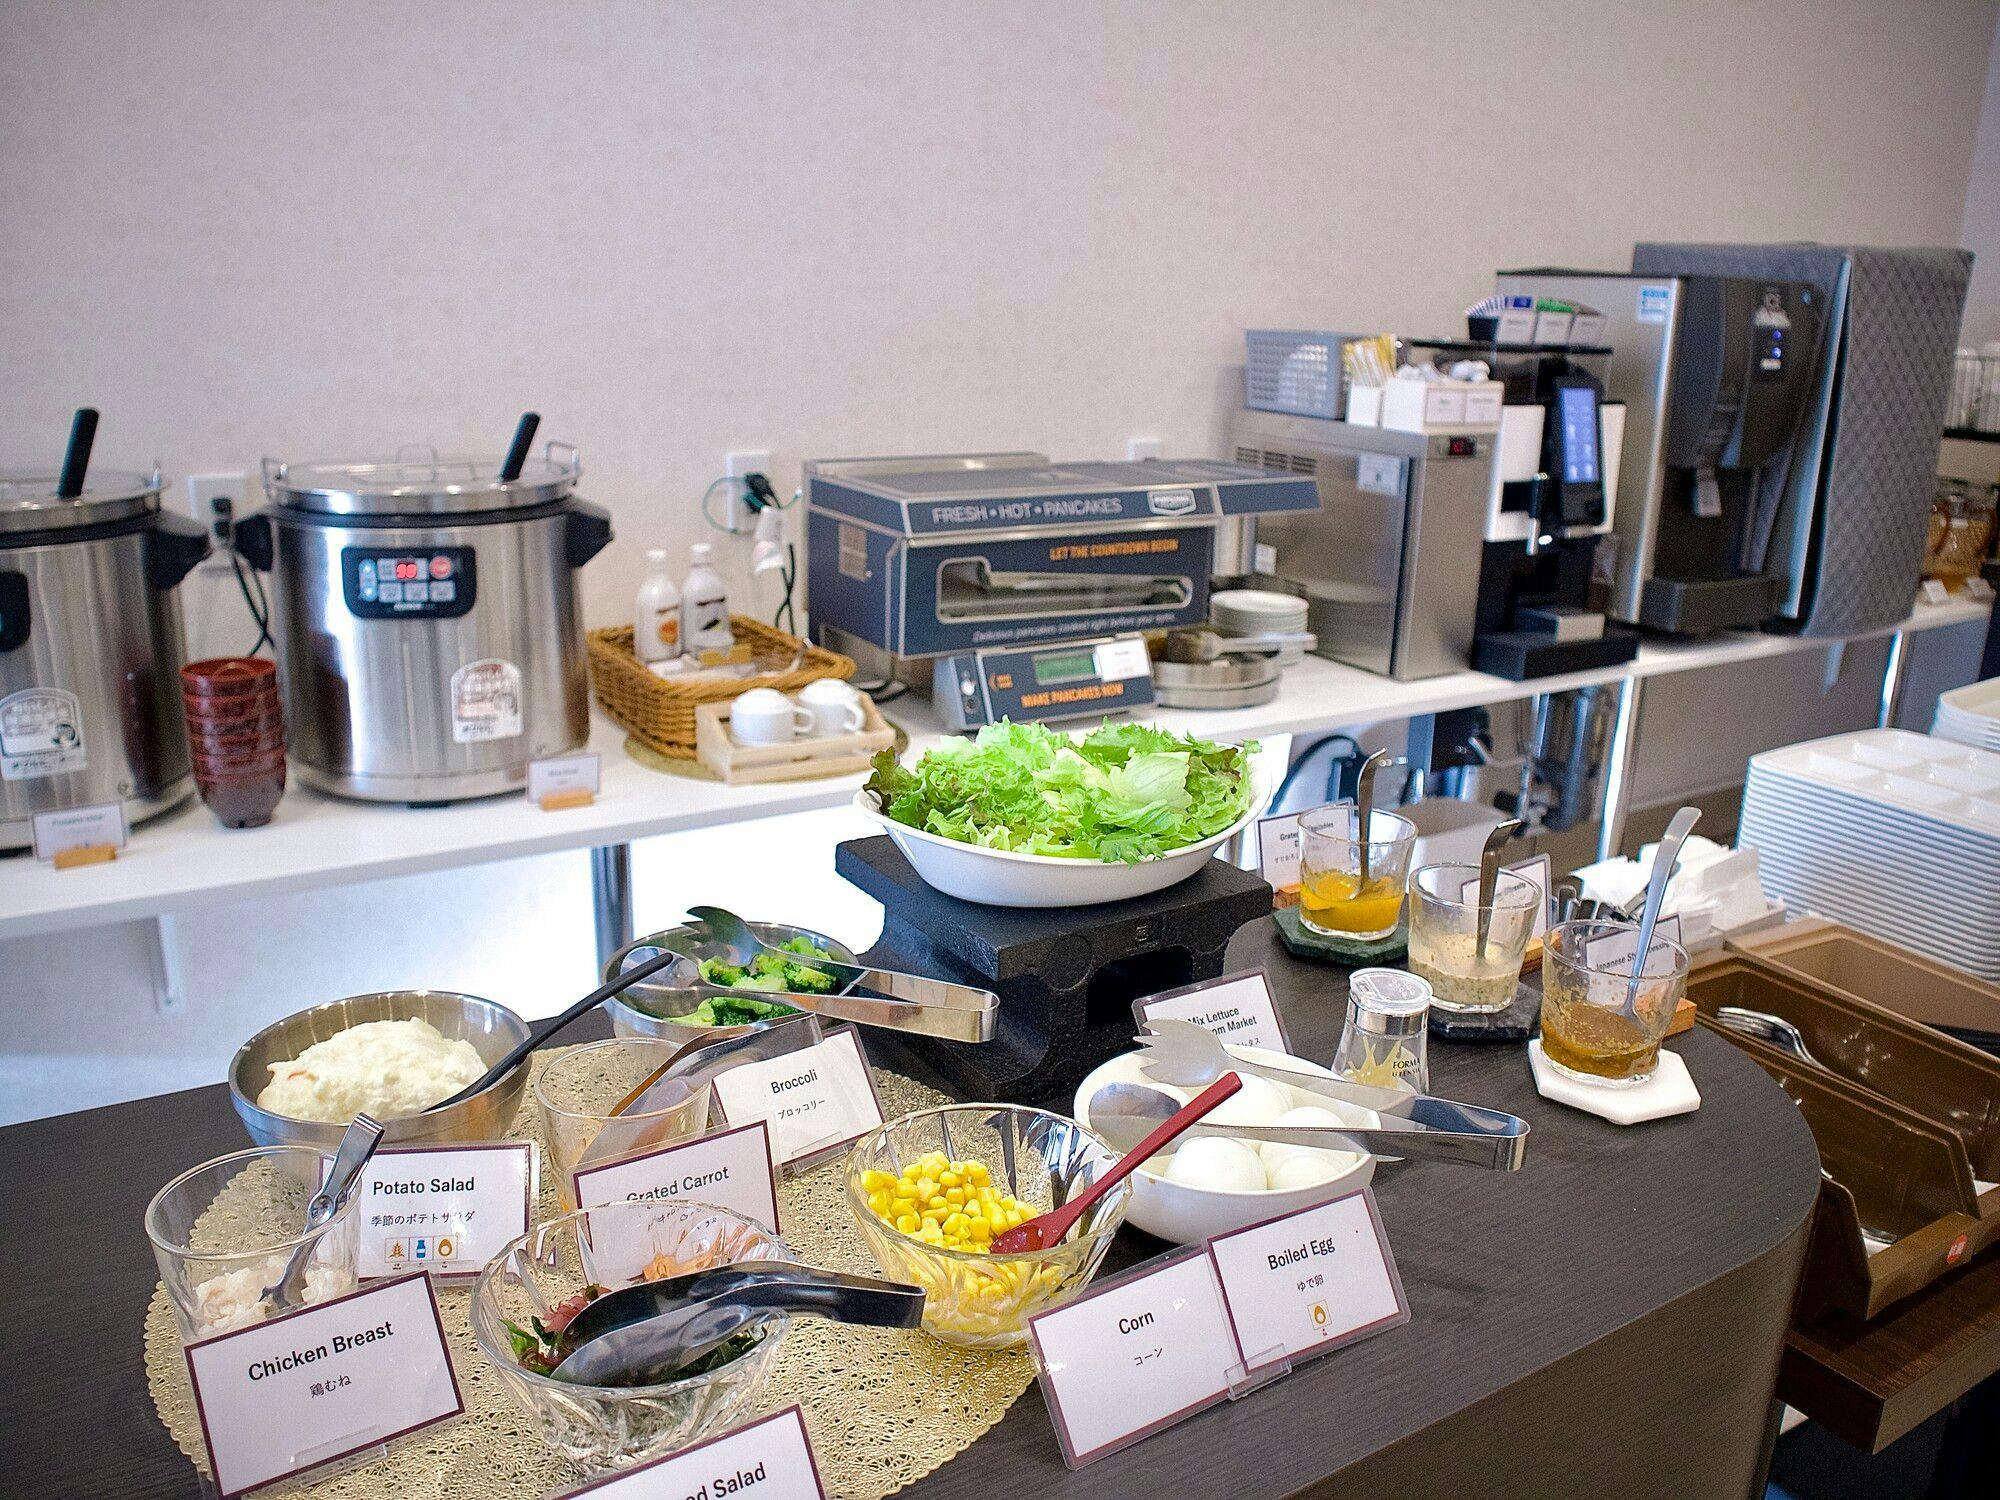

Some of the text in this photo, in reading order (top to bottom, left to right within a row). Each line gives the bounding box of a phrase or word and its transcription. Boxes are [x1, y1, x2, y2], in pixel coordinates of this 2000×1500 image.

[932, 498, 1123, 524] FRESH HOT PANCAKES
[1090, 541, 1150, 557] COUNTDOWN
[1206, 1007, 1240, 1023] Lettuce
[1226, 1015, 1258, 1032] Market
[770, 1069, 818, 1094] Broccoli
[778, 1099, 825, 1120] ブロッコリー
[373, 1177, 475, 1196] Potato Salad
[682, 1166, 730, 1191] Carrot
[371, 1210, 476, 1227] 季節のポテトサダ
[1267, 1236, 1336, 1271] Boiled Egg
[1296, 1273, 1325, 1293] ゆで卵
[1118, 1310, 1155, 1335] Corn
[248, 1321, 394, 1381] Chicken Breast
[1133, 1346, 1164, 1367] コーン
[309, 1374, 352, 1399] 鶏むね
[712, 1462, 767, 1498] Salad
